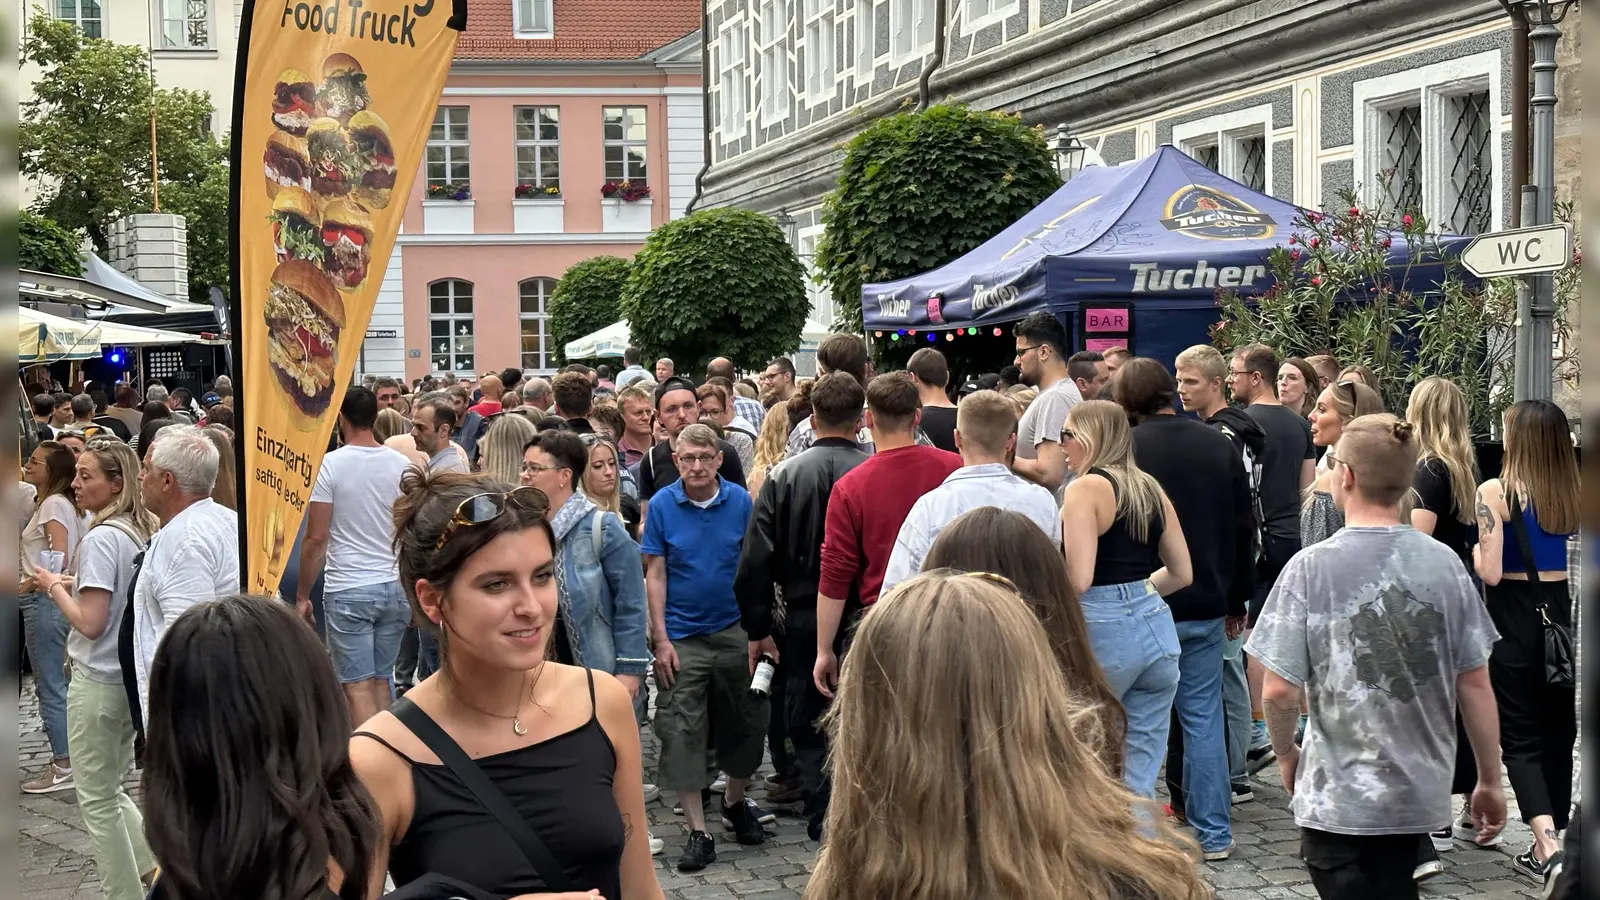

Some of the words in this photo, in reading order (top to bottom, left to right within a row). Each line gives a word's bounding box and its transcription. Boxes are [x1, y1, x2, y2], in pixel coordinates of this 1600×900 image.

[280, 0, 340, 35] Food
[348, 0, 417, 48] Truck
[1174, 210, 1261, 227] Tucher
[1497, 237, 1541, 265] WC
[1129, 260, 1266, 292] Tucher
[877, 293, 911, 317] Tucher
[971, 284, 1020, 310] Tucher
[1089, 315, 1124, 327] BAR
[255, 467, 283, 496] saftig
